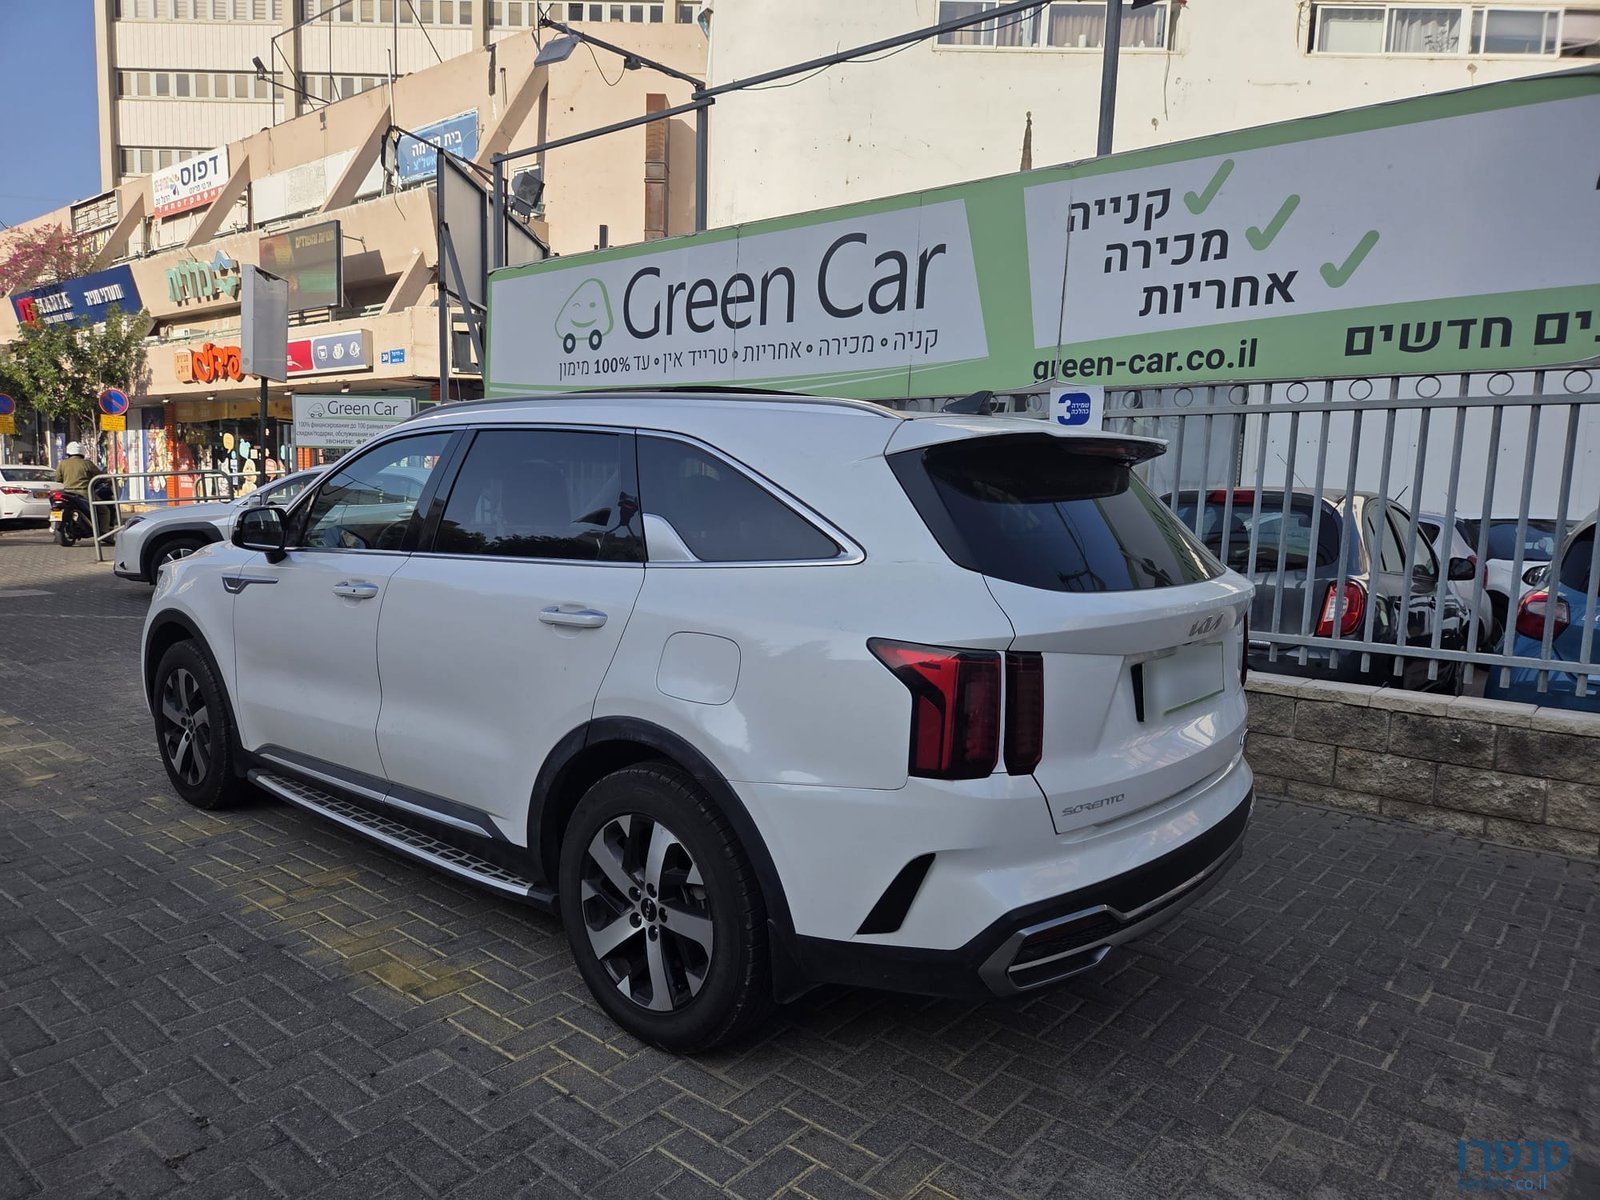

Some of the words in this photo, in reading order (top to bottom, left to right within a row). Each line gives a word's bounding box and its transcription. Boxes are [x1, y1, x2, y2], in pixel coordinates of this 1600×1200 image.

[444, 130, 463, 147] בית
[180, 154, 219, 187] דפוס
[1066, 187, 1171, 232] קנייה
[1103, 229, 1229, 273] מכירה
[623, 266, 796, 340] Green
[817, 232, 947, 319] Car
[1138, 270, 1299, 317] אחריות
[1344, 316, 1513, 357] חדשים
[1534, 310, 1600, 346] ים
[742, 340, 803, 362] אחריות
[818, 334, 875, 357] מכירה
[893, 328, 939, 354] קניה
[593, 356, 631, 374] 100%
[633, 354, 651, 371] עד
[663, 352, 684, 374] אין
[688, 347, 729, 366] טרייד
[1033, 337, 1258, 384] green-car.co.il
[558, 358, 590, 382] מימון
[327, 400, 370, 415] Green
[373, 401, 399, 416] Car
[1057, 399, 1071, 420] 3
[297, 421, 311, 429] 100%
[1062, 793, 1126, 817] SORENTO
